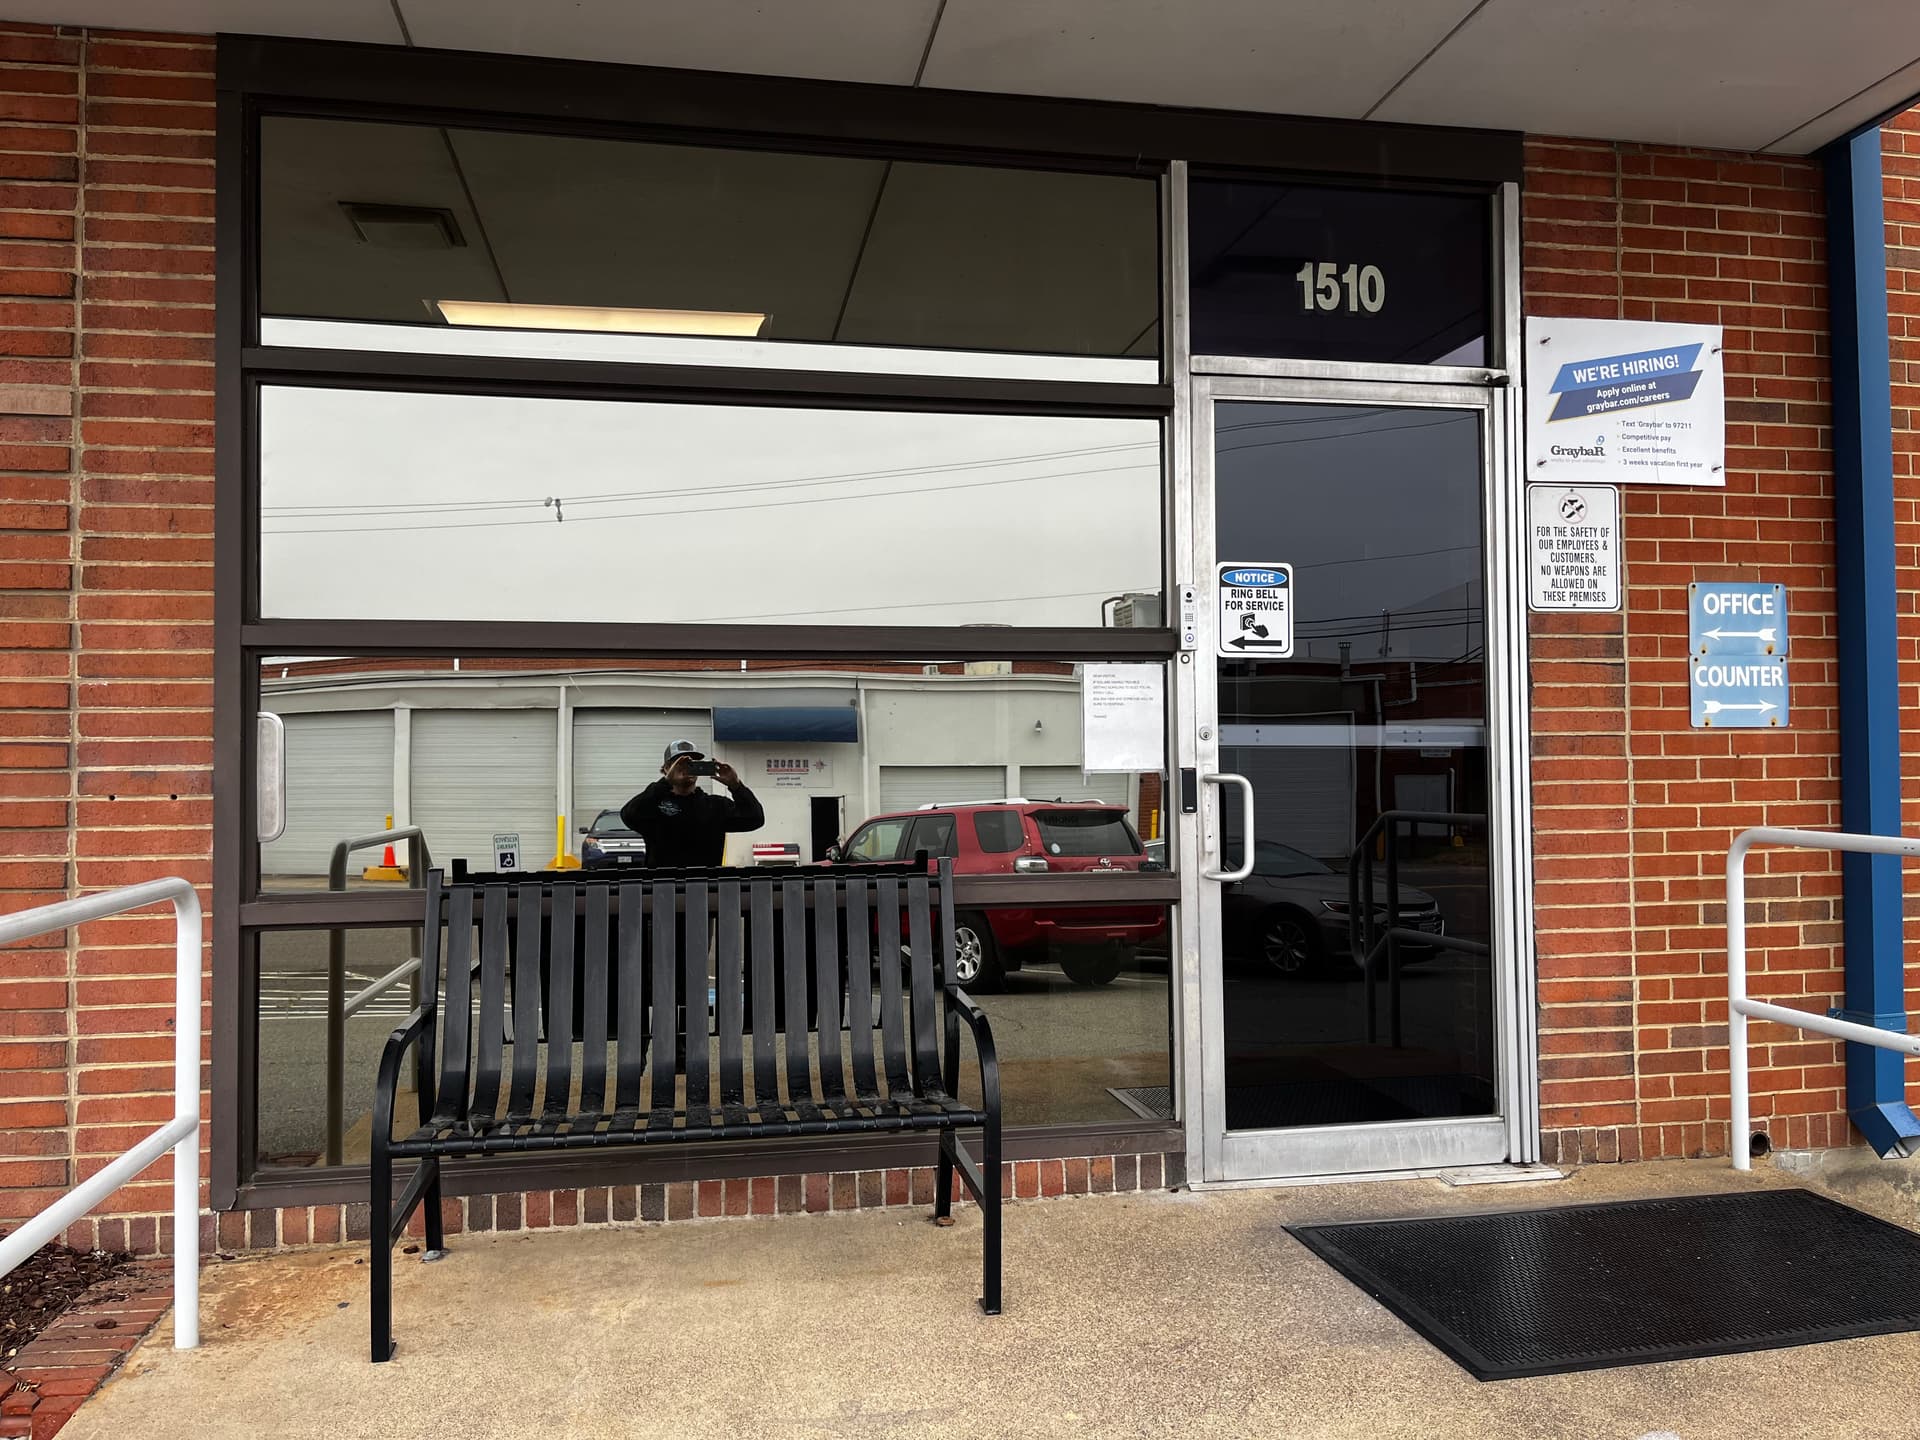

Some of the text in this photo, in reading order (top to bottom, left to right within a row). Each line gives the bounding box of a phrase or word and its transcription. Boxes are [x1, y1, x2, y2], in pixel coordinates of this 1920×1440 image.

[1296, 262, 1385, 312] 1510
[1573, 354, 1680, 384] WE'RE HIRING!
[1596, 381, 1657, 399] Apply online at
[1586, 392, 1670, 413] graybar.com/careers
[1621, 420, 1636, 428] Text
[1672, 422, 1692, 430] 97211
[1621, 433, 1671, 443] Competitive pay
[1651, 447, 1677, 455] benefits
[1676, 460, 1689, 468] first
[1690, 462, 1704, 470] year
[1536, 526, 1610, 538] FOR THE SAFETY OF
[1538, 539, 1608, 551] OUR EMPLOYEES &
[1540, 565, 1607, 576] NO WEAPONS ARE
[1234, 573, 1275, 583] NOTICE
[1551, 578, 1598, 589] ALLOWED ON
[1230, 588, 1278, 599] RING BELL
[1543, 590, 1607, 602] THESE PREMISES
[1225, 600, 1284, 611] FOR SERVICE
[1703, 593, 1774, 615] OFFICE
[1694, 665, 1784, 687] COUNTER
